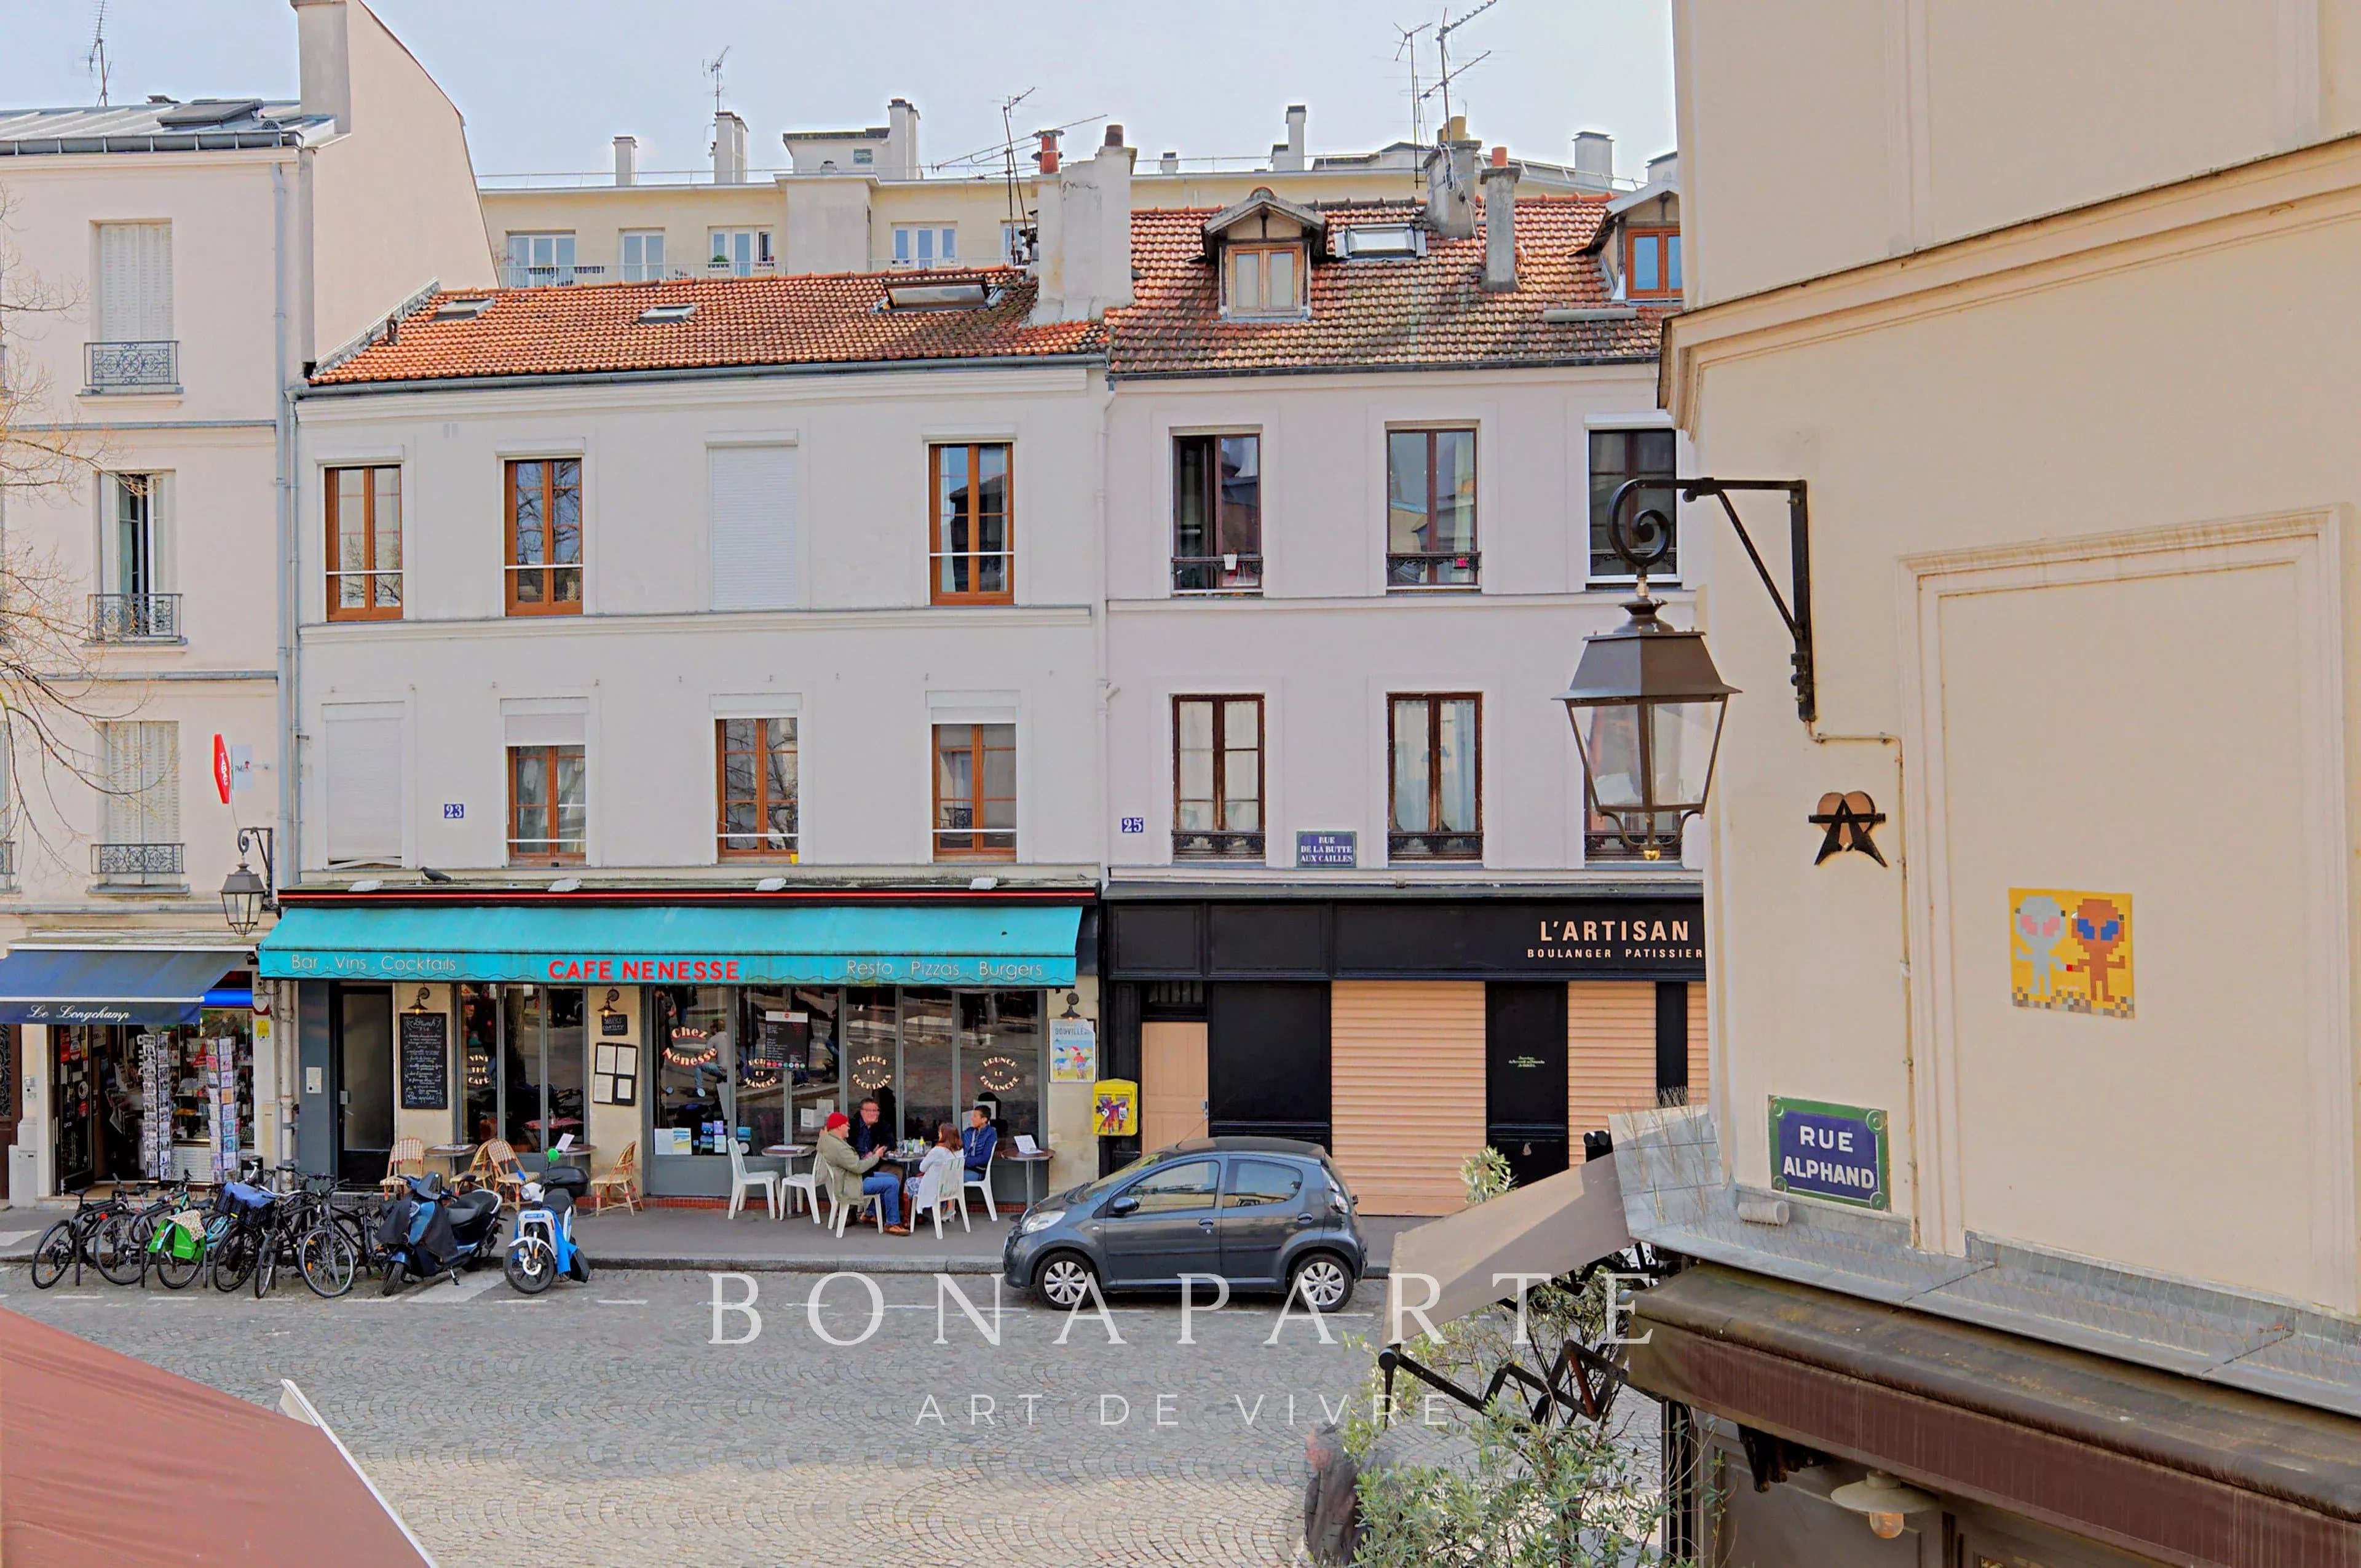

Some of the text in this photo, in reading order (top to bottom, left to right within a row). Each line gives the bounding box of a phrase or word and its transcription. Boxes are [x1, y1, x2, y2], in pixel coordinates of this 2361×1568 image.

[446, 804, 462, 817] 23
[1123, 818, 1142, 832] 25
[1540, 920, 1689, 941] L'ARTISAN
[1527, 948, 1703, 959] BOULANGER PATISSIER
[291, 954, 456, 972] Bar Vins Cocktails
[548, 960, 740, 980] CAFE NENESSE
[847, 959, 1043, 980] Resto Pizzas Burgers
[27, 1004, 131, 1023] Le Longchamp
[671, 1026, 708, 1040] Chez
[469, 1054, 489, 1063] VINS
[662, 1047, 718, 1067] Nénesse
[982, 1056, 1018, 1069] BRUNCH
[745, 1076, 777, 1088] MANGER
[852, 1074, 892, 1090] COCKTAILS
[979, 1075, 1020, 1091] DIMANCHE
[1799, 1125, 1853, 1154] RUE
[1783, 1155, 1875, 1189] ALPHAND
